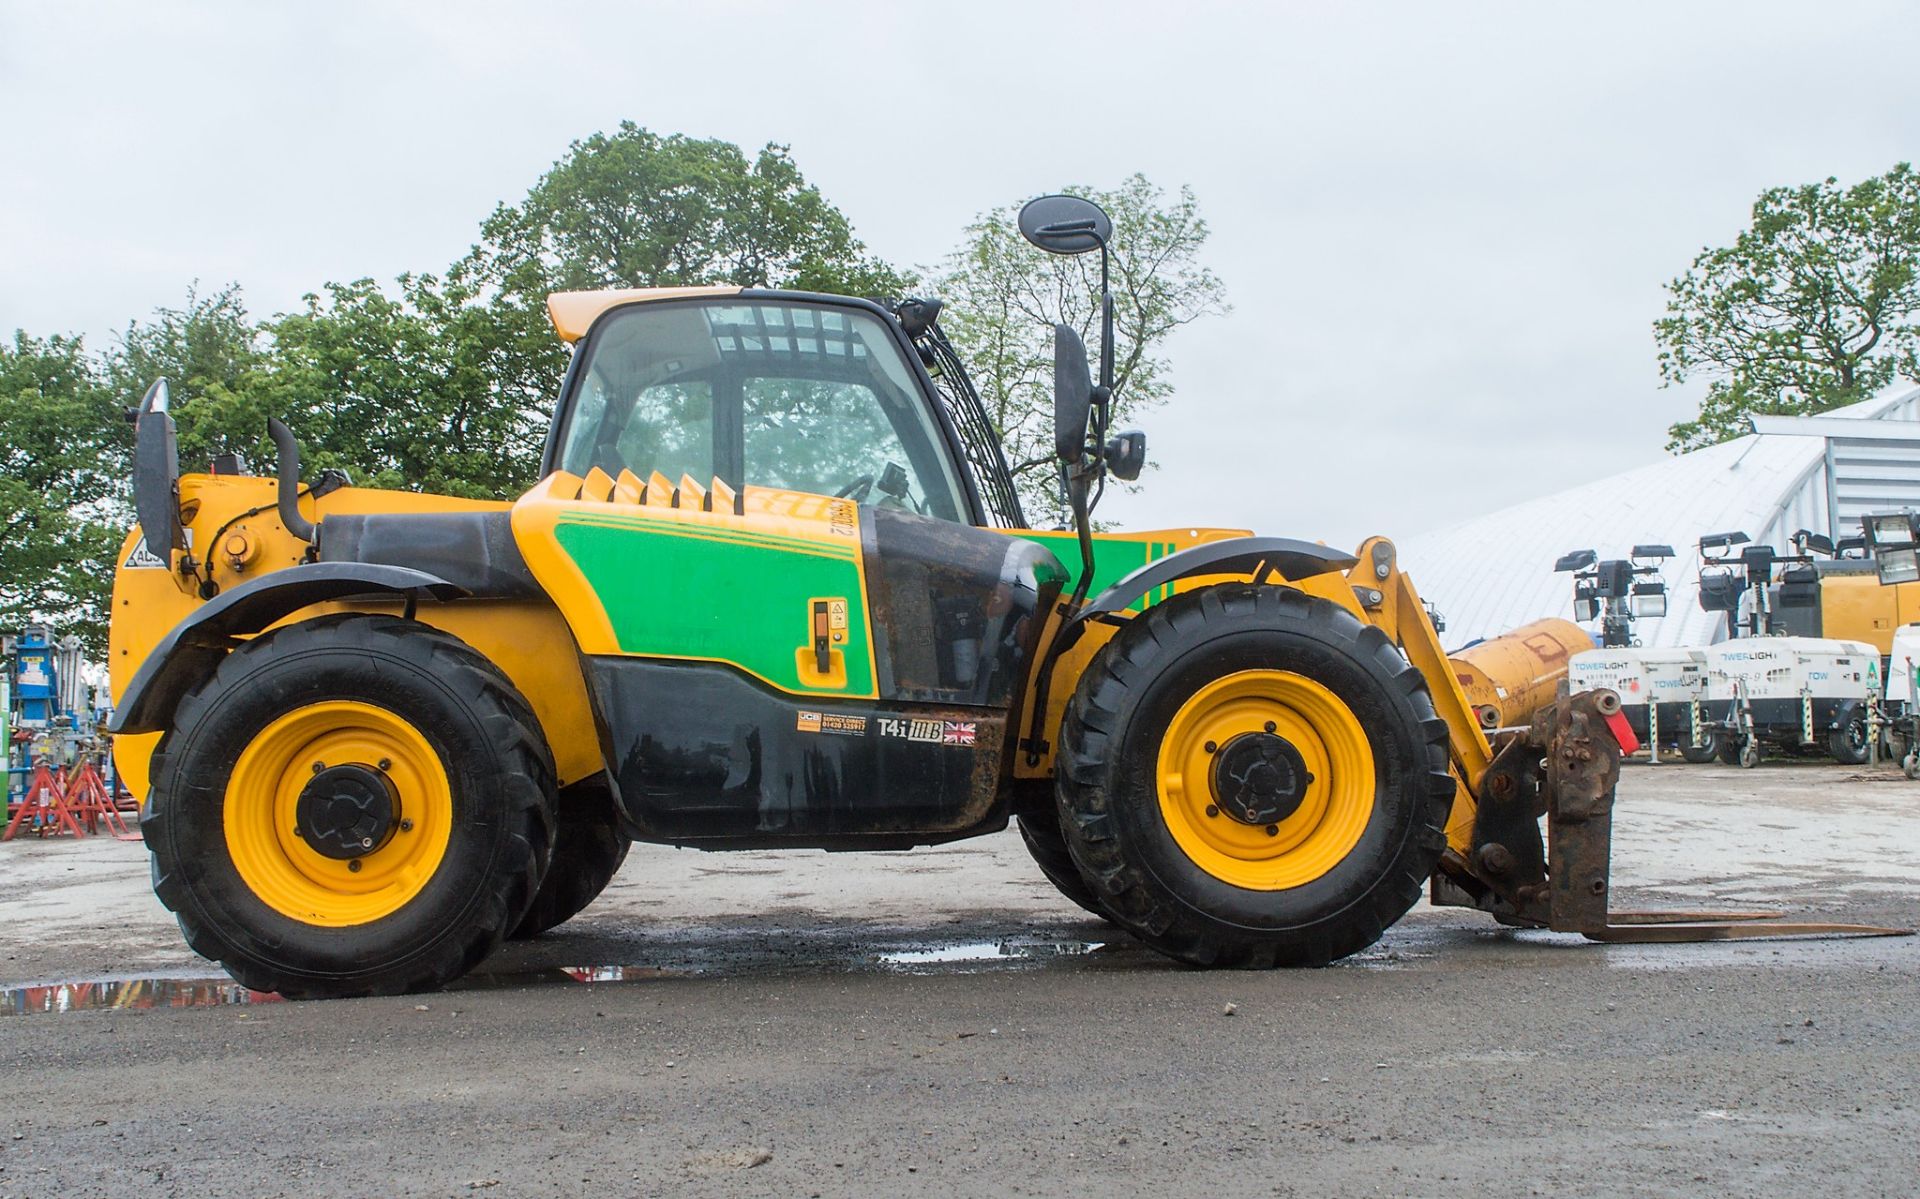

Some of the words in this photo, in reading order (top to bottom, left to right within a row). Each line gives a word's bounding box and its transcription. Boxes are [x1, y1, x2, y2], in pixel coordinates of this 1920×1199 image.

[1574, 662, 1629, 670] TOWERLIGHT
[823, 716, 845, 724] SERVICE
[877, 718, 907, 737] T4i
